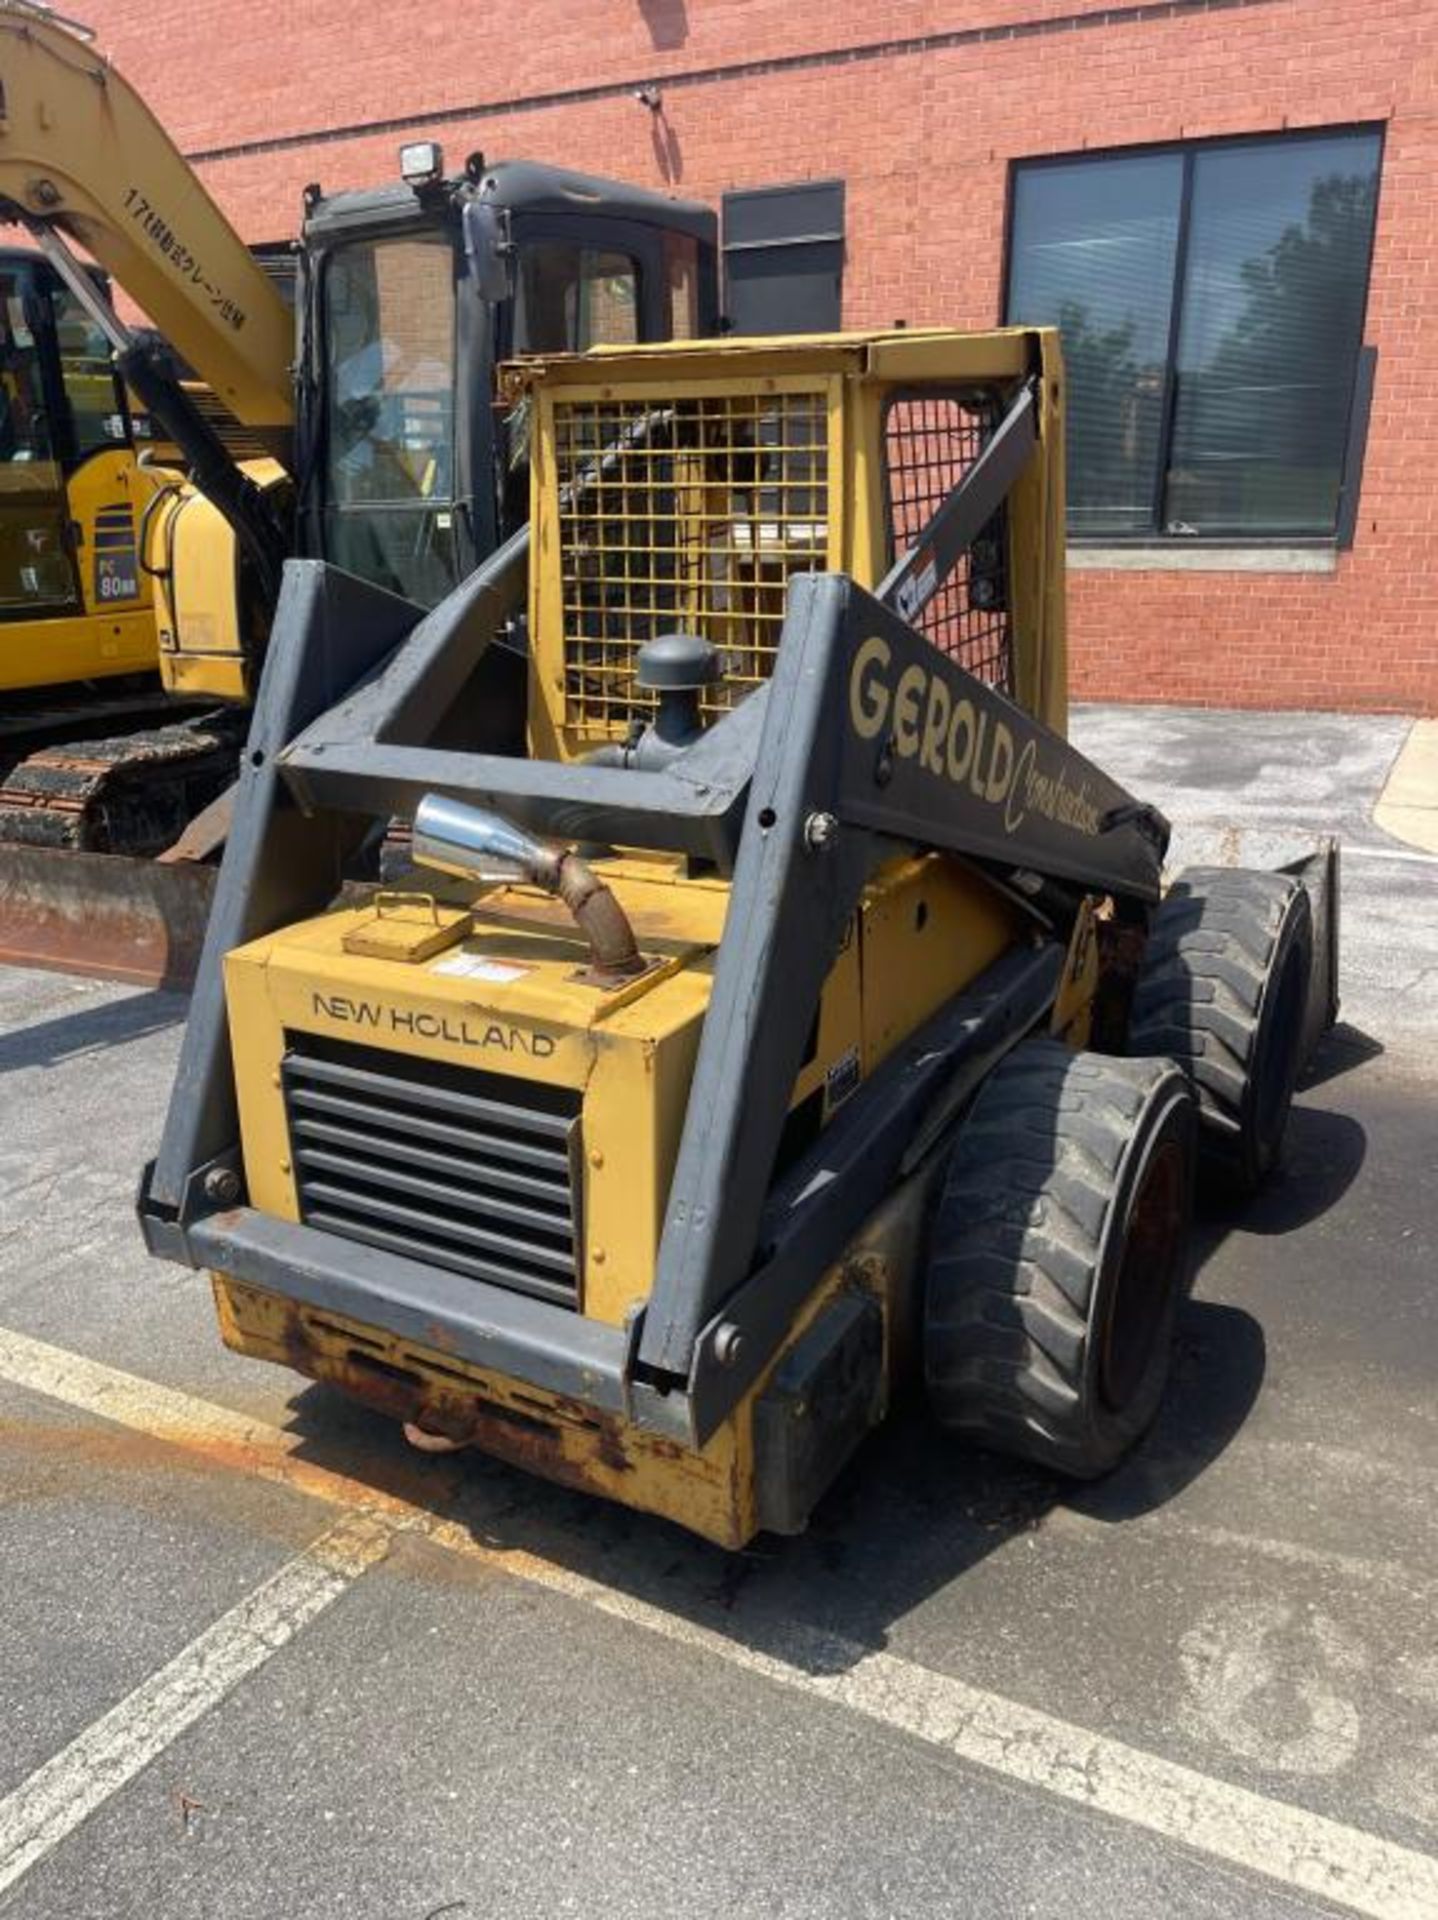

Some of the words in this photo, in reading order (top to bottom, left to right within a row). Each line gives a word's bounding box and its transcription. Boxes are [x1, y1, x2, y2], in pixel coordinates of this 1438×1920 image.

[850, 637, 1014, 803] GEROLD
[313, 992, 382, 1027] NEW
[391, 1008, 556, 1058] HOLLAND
